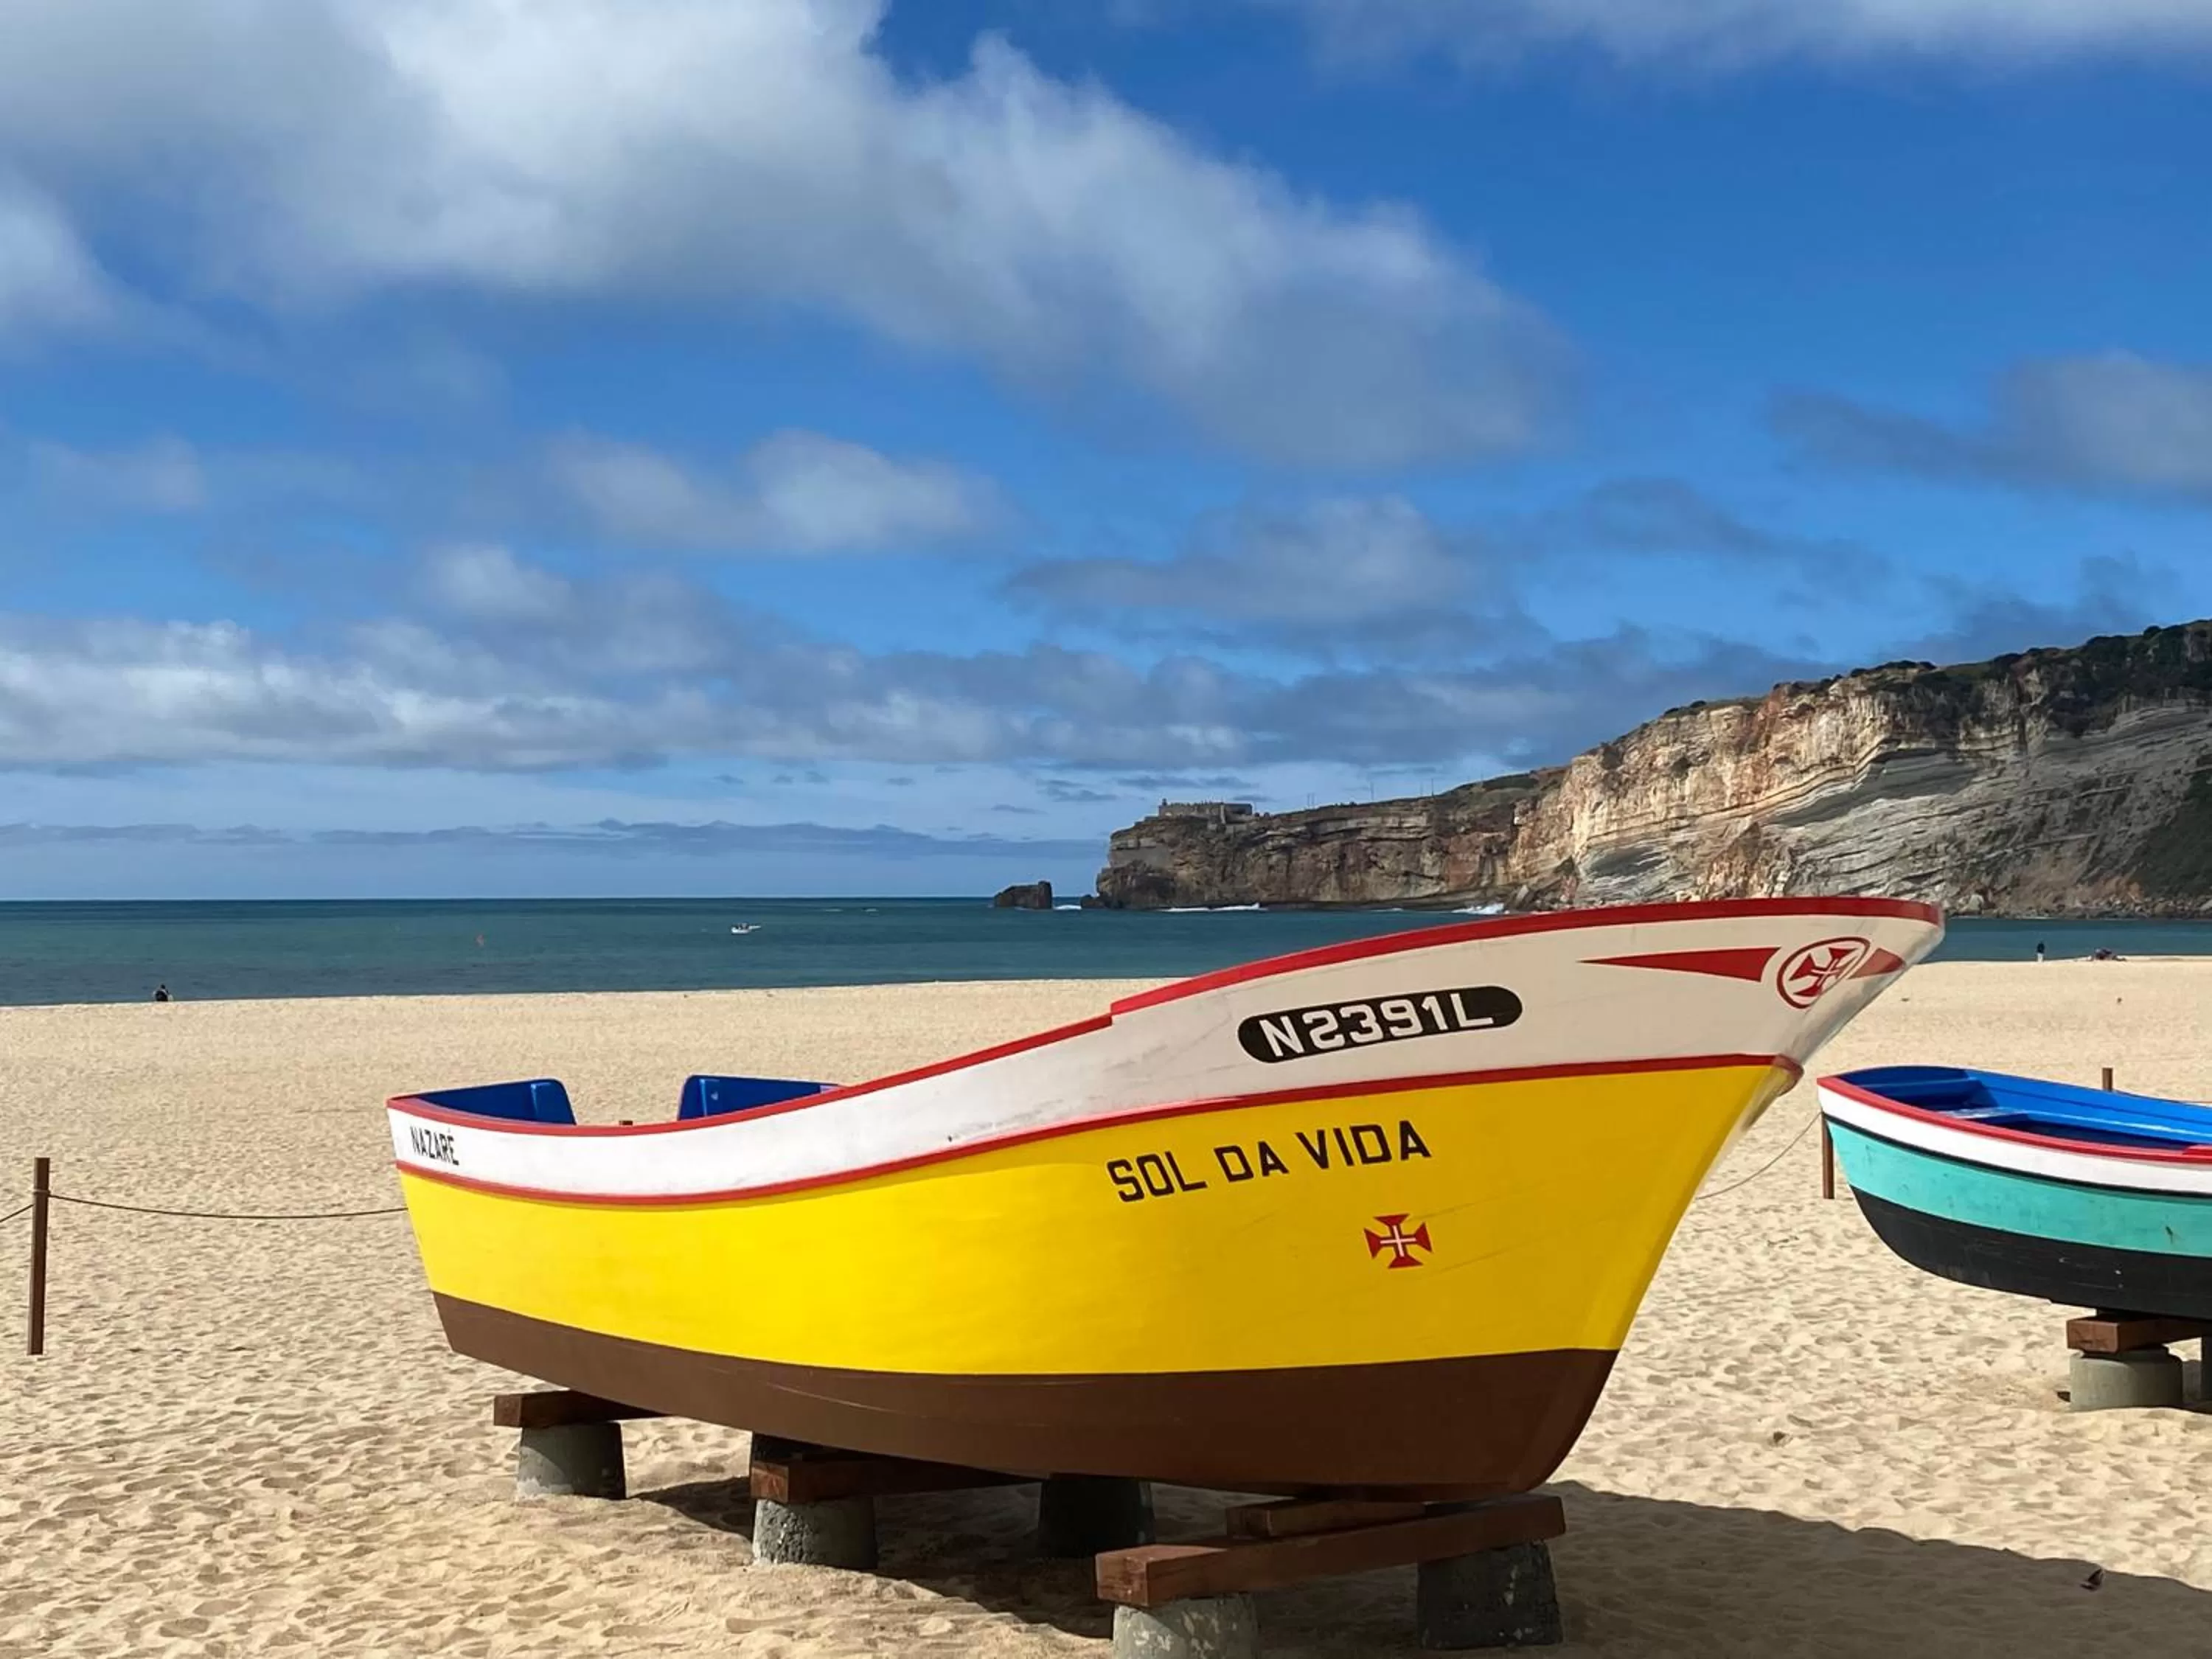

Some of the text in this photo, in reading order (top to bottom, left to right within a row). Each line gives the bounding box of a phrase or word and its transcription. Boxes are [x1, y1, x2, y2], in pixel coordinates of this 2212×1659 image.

[1259, 993, 1495, 1057] N2391L
[410, 1125, 460, 1166] NAZARÉ
[1107, 1119, 1432, 1203] SOL DA VIDA
